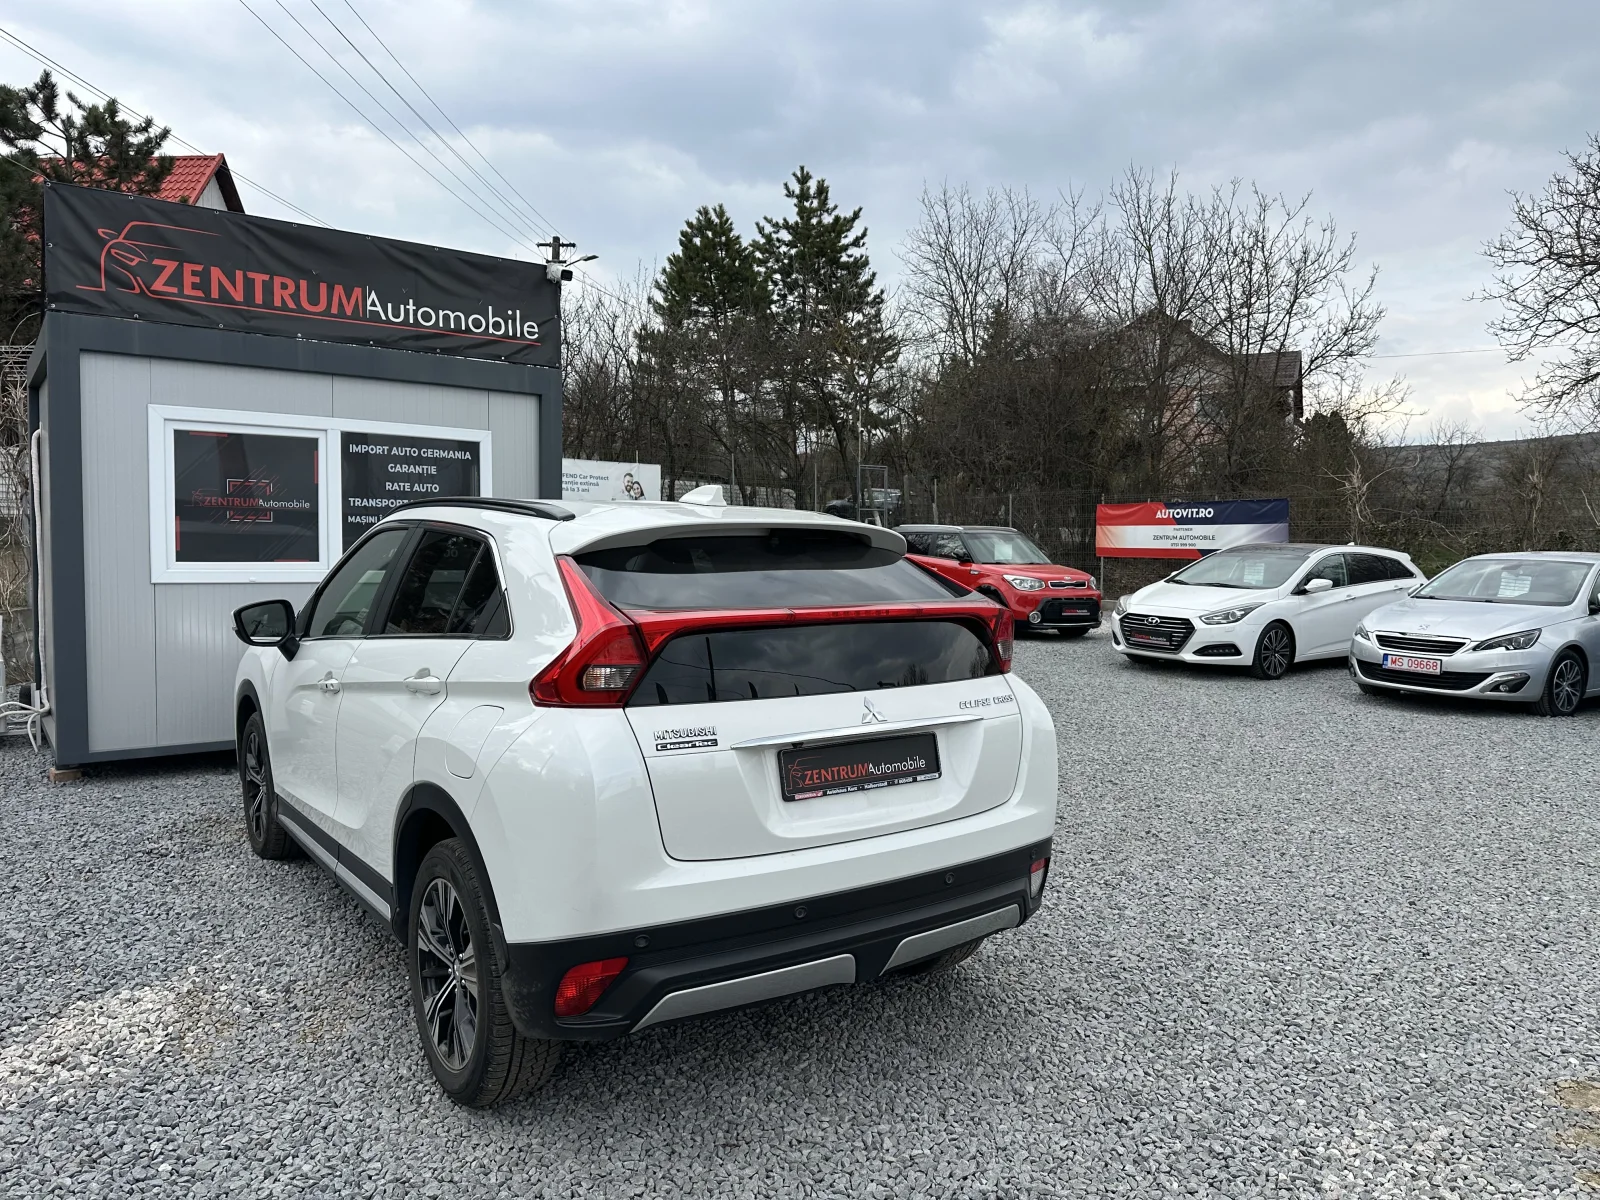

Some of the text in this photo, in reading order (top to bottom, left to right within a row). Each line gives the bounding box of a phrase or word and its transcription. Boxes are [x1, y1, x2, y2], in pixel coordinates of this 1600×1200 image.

[151, 258, 539, 340] ZENTRUM Automobile
[349, 444, 471, 460] IMPORT AUTO GERMANIA
[385, 482, 439, 493] RATE AUTO
[204, 496, 310, 509] ZENTRUM Automobile
[347, 515, 378, 525] MAȘINI
[1155, 507, 1214, 519] AUTOVIT.RO
[1390, 657, 1438, 671] MS 09668
[959, 694, 1014, 709] ECLIPSE CROSS
[654, 726, 718, 741] MITSUBISHI
[657, 739, 717, 751] ClearTec
[804, 755, 926, 785] ZENTRUM Automobile
